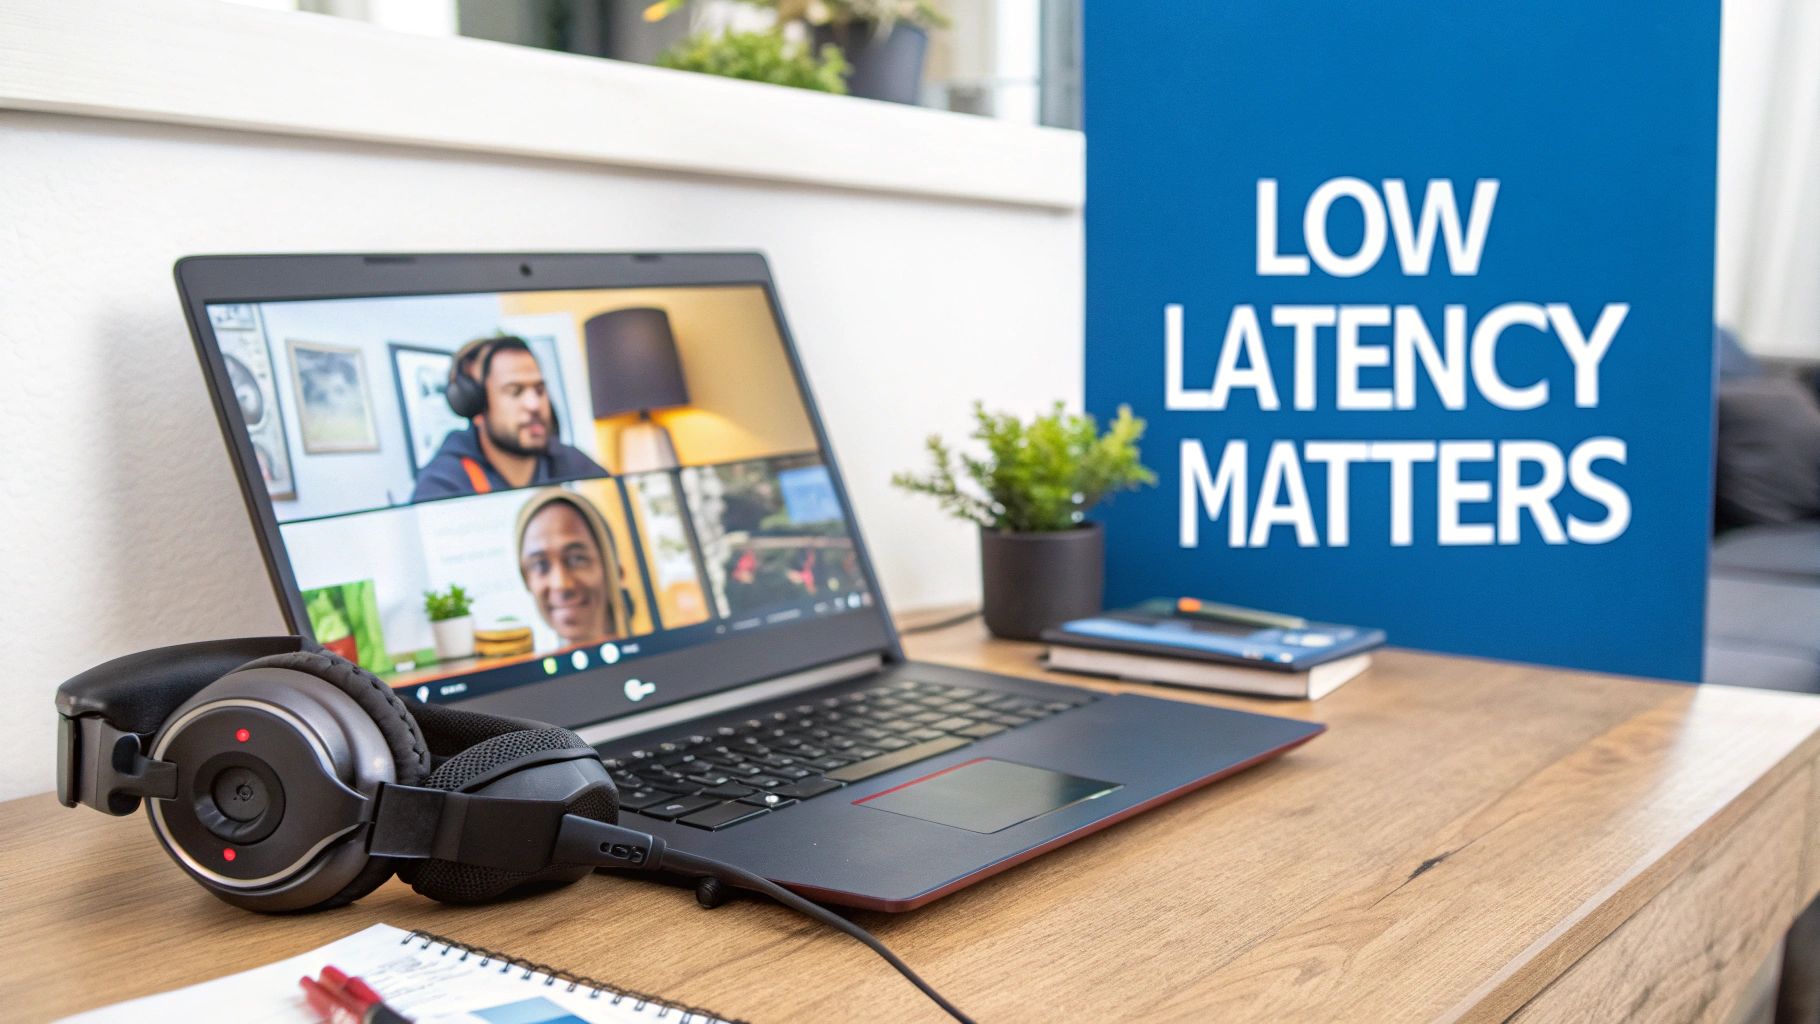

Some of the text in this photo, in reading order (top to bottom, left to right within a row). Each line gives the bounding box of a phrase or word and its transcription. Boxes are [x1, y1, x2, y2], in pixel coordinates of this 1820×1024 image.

[1256, 177, 1500, 276] LOW
[1164, 303, 1630, 410] LATENCY
[1179, 438, 1631, 548] MATTERS
